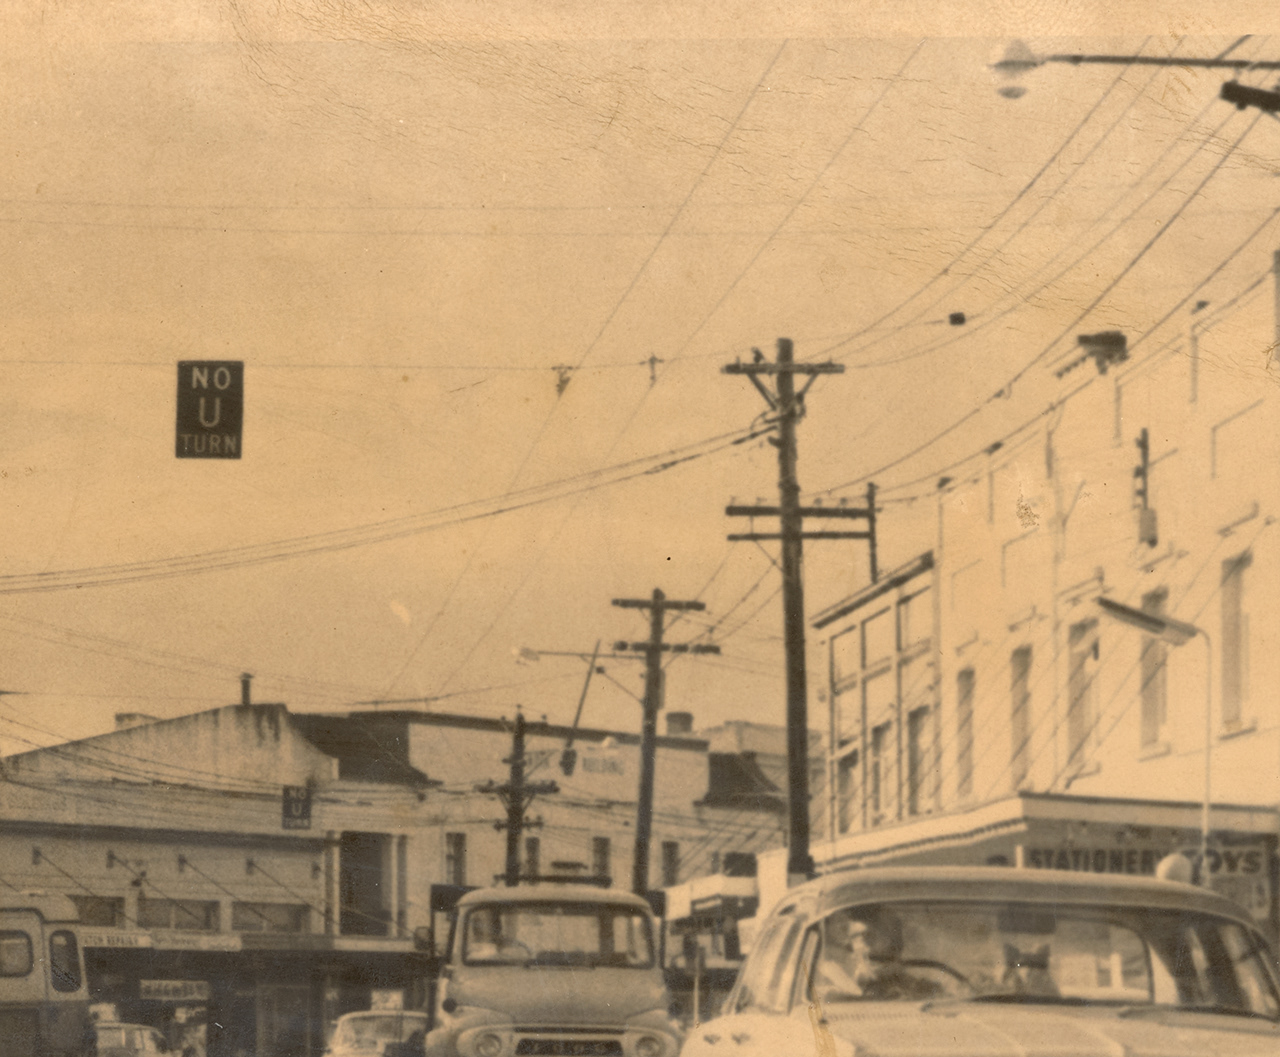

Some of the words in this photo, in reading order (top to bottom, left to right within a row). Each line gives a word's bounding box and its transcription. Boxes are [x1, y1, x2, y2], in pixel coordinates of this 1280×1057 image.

[191, 366, 231, 390] NO
[200, 397, 220, 428] U
[180, 433, 237, 453] TURN
